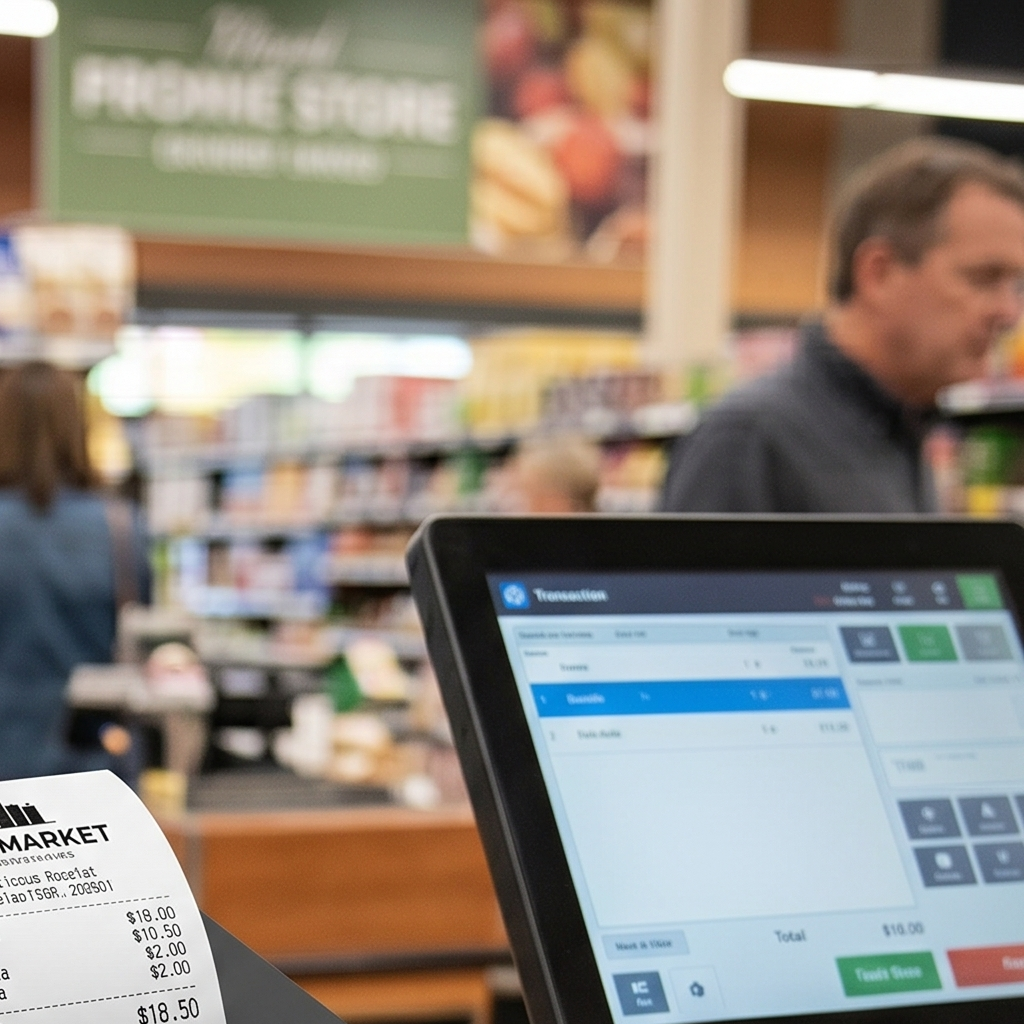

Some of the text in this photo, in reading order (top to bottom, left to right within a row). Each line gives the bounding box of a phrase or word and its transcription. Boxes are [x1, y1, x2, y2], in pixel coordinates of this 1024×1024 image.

[533, 587, 609, 602] Transaction
[126, 906, 176, 925] $18.00
[132, 923, 182, 943] $10.50
[774, 921, 925, 944] Total $10.00
[145, 941, 187, 960] $2.00
[149, 960, 191, 980] $2.00
